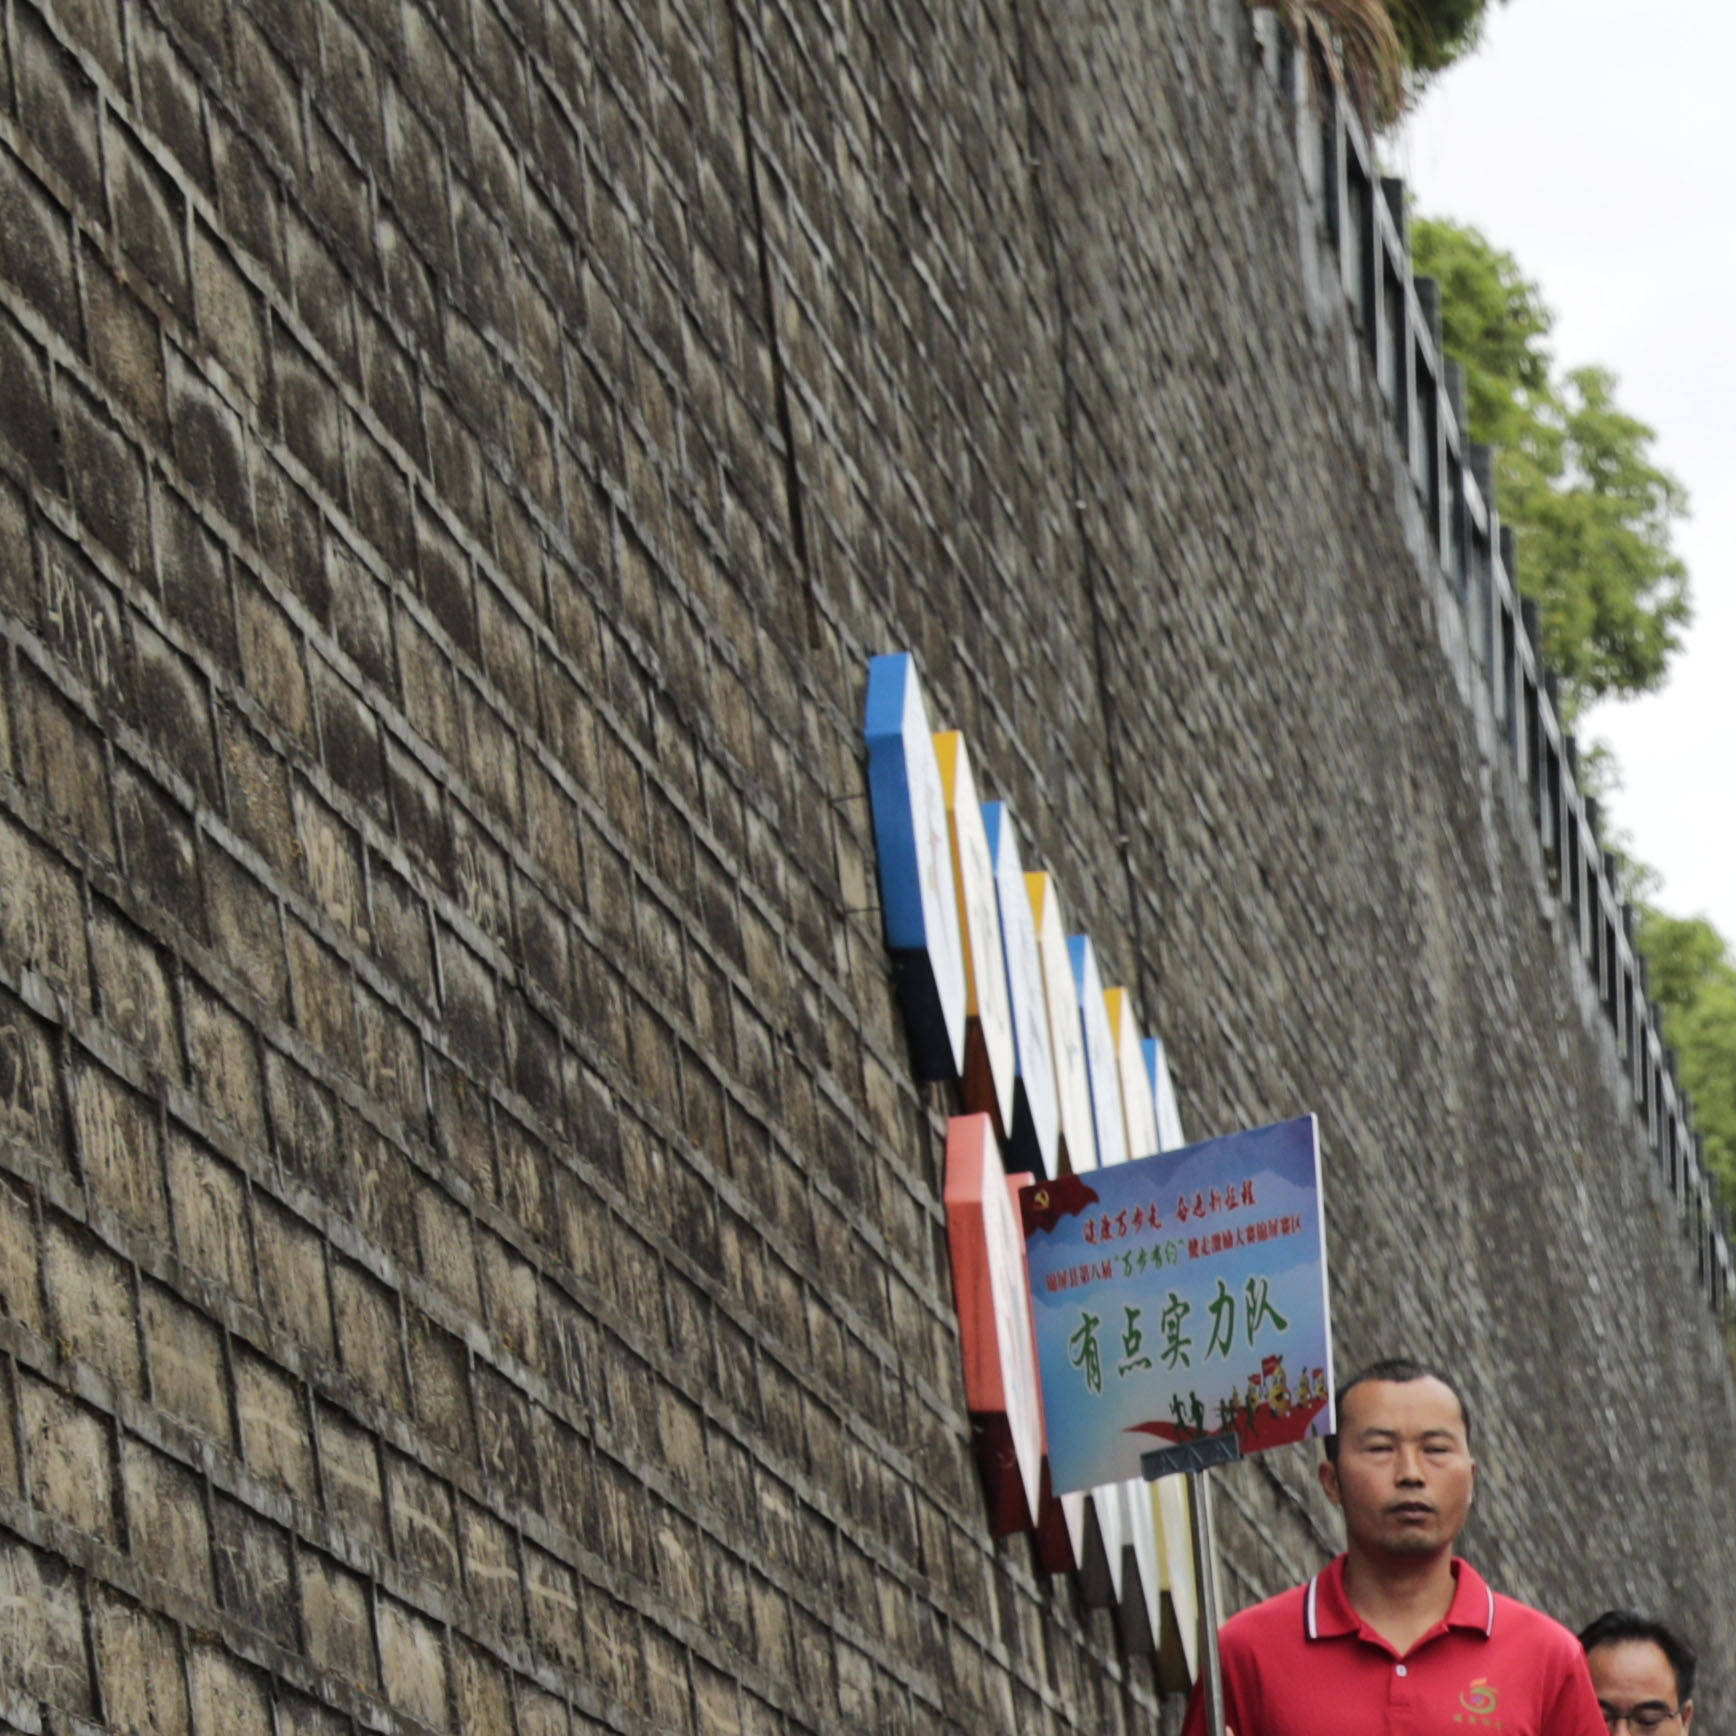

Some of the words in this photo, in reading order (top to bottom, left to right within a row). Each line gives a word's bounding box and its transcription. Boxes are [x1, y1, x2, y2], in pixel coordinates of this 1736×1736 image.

[1069, 1276, 1288, 1394] 有点实力队
